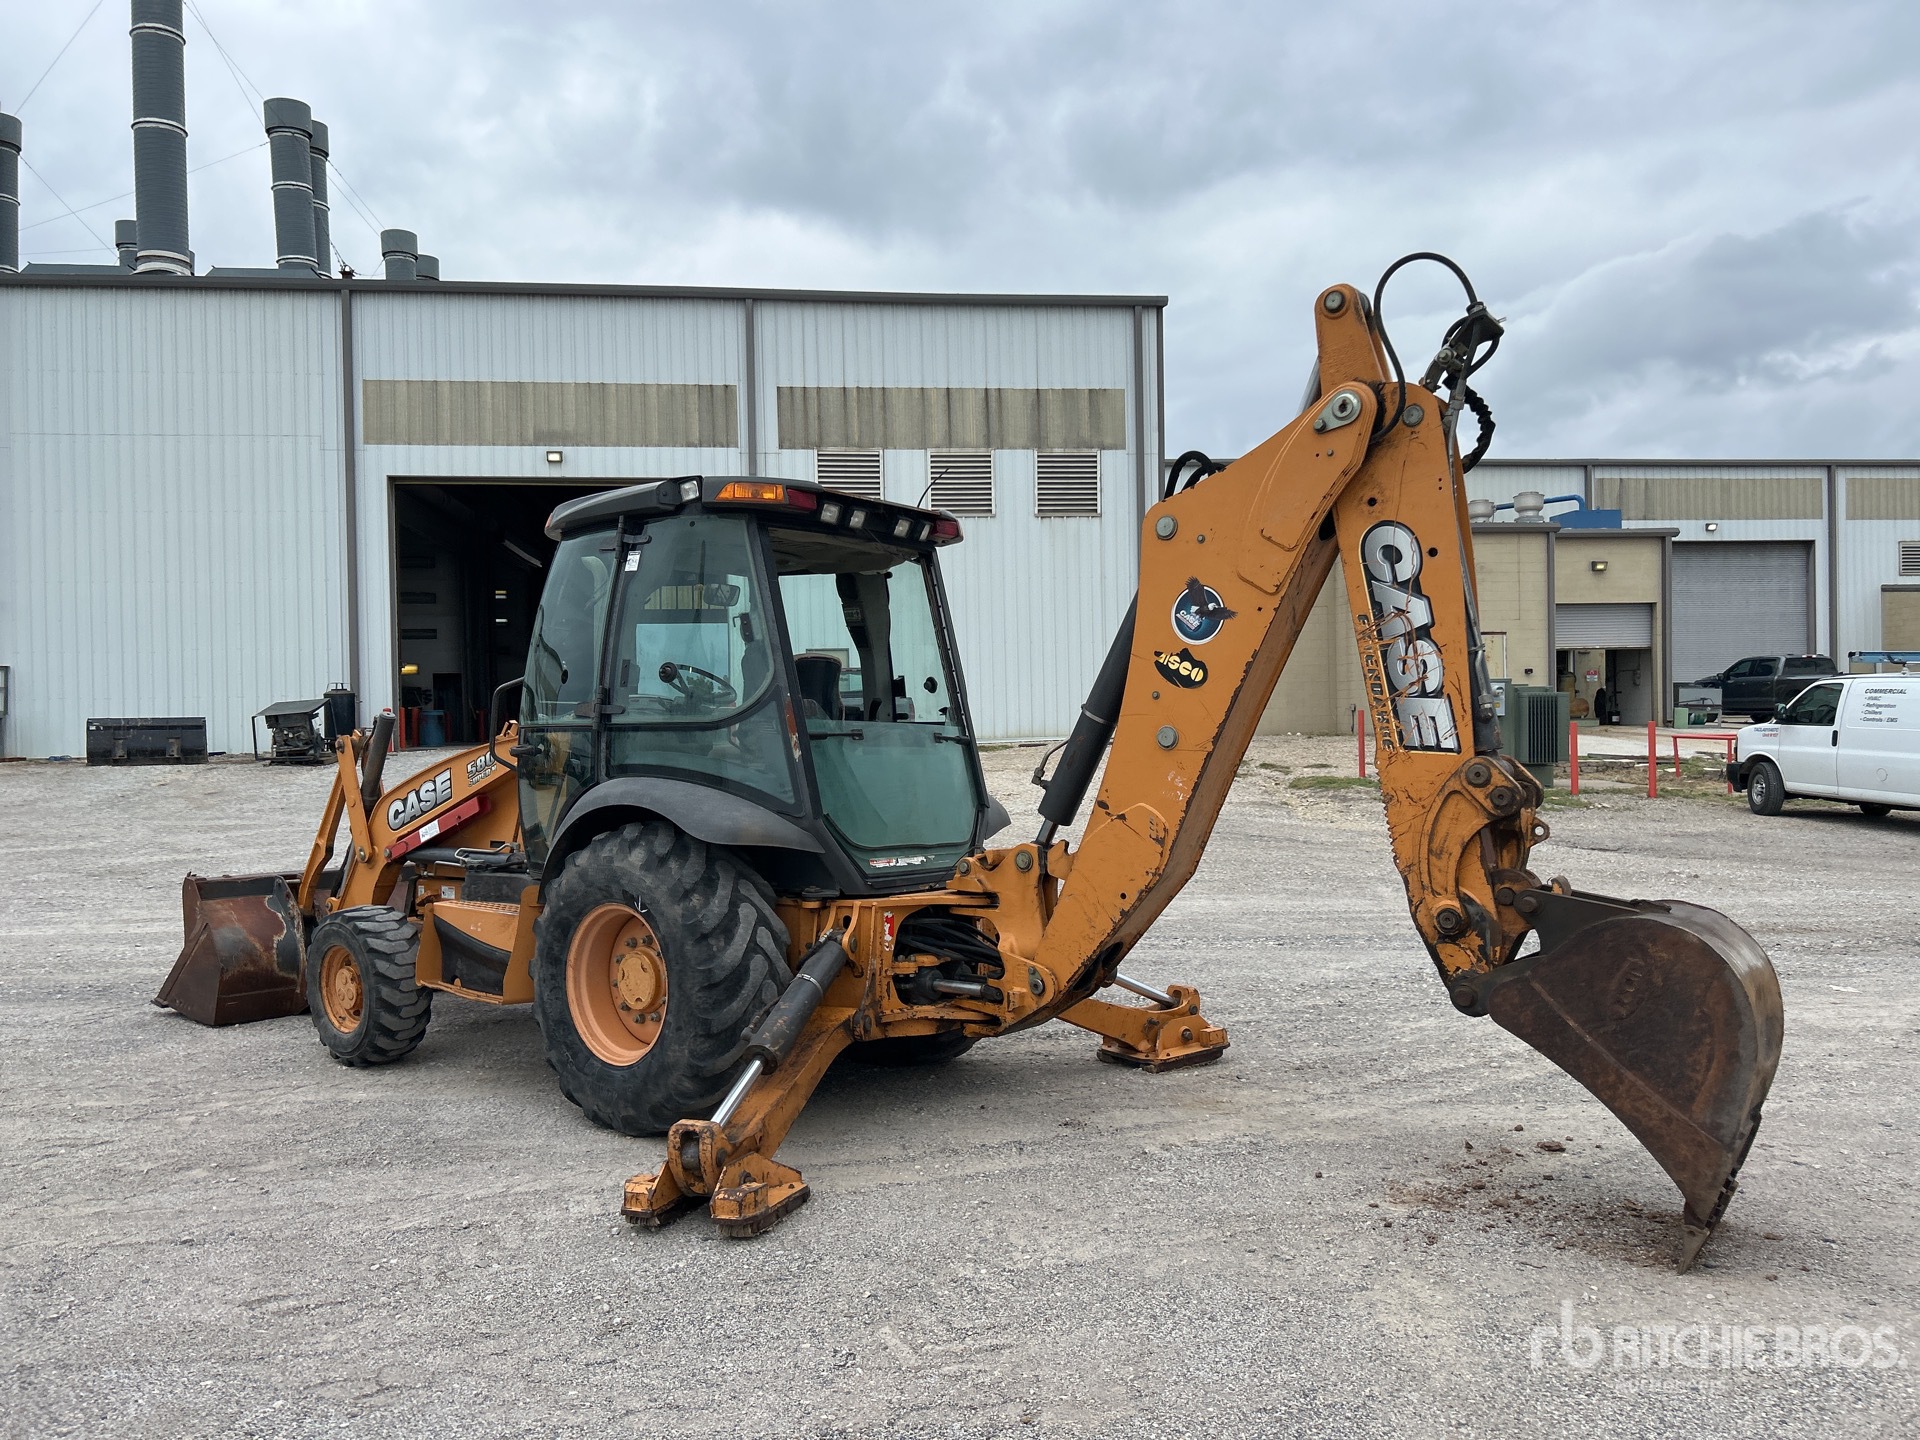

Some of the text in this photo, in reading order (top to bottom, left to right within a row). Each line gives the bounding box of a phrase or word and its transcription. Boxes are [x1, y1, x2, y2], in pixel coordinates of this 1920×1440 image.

[1363, 521, 1460, 754] CASE
[466, 750, 496, 779] 580
[387, 767, 453, 831] CASE
